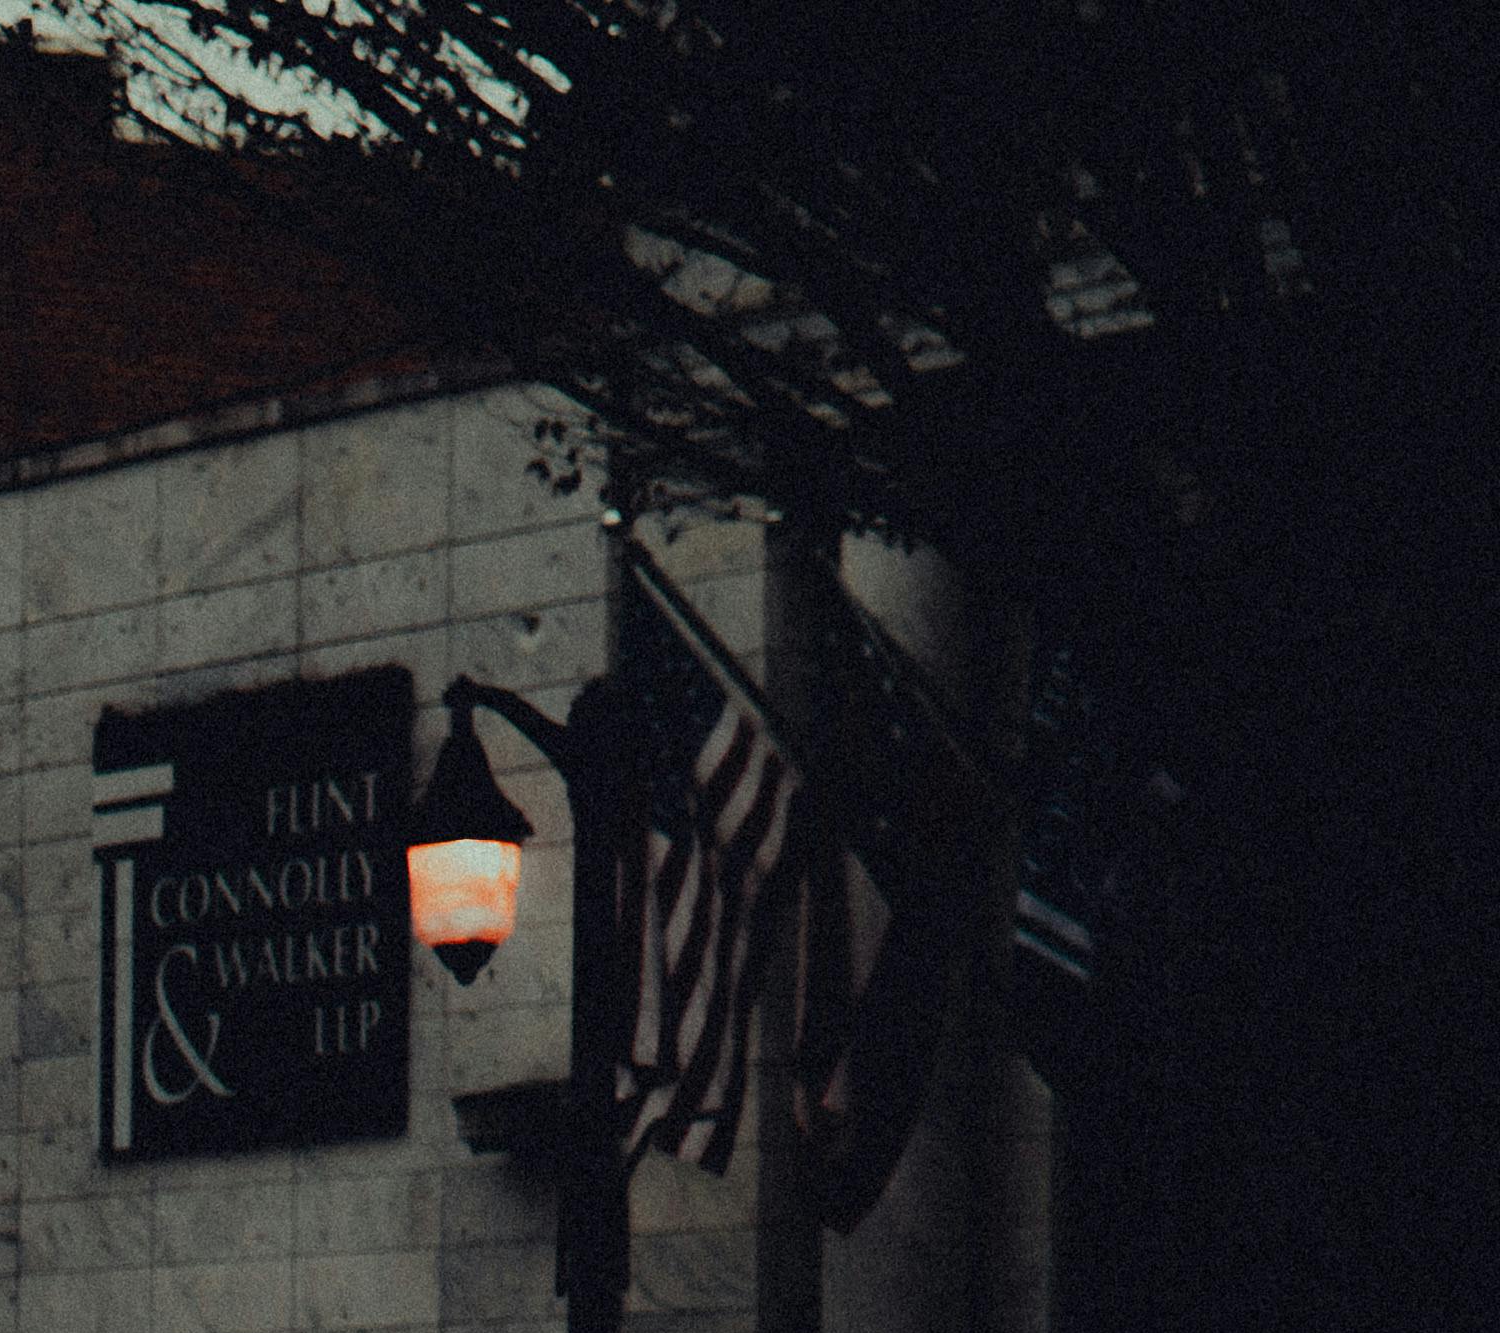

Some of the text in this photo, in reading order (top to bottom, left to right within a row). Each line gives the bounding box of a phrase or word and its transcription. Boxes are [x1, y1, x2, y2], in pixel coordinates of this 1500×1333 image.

[266, 772, 380, 834] FLINT
[150, 849, 374, 928] CONNOLLY
[143, 923, 381, 1103] & WALKER
[314, 999, 382, 1056] LLP
